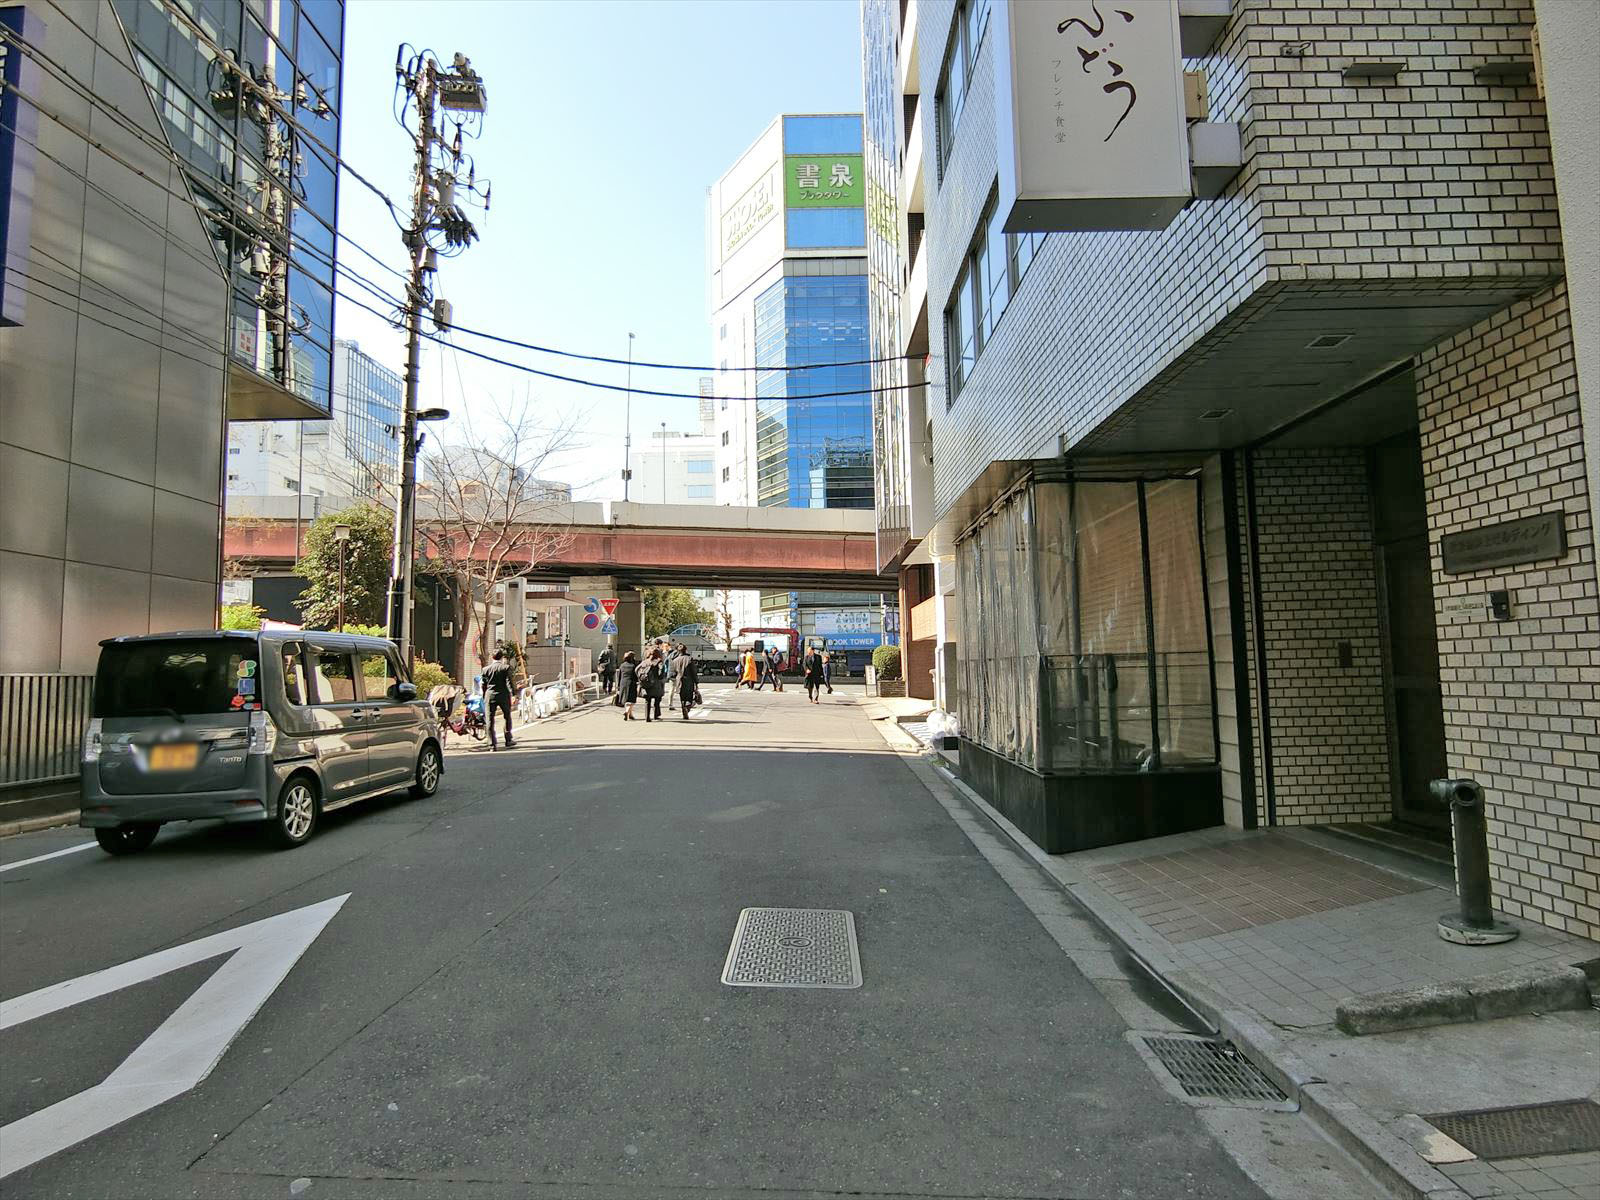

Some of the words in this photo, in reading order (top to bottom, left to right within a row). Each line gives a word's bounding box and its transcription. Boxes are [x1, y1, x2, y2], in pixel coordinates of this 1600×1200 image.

[1051, 59, 1067, 144] フレンチ食堂
[796, 163, 854, 189] 書泉
[800, 191, 849, 201] ブックタワー
[828, 638, 848, 646] BOOK
[850, 638, 875, 646] TOWER
